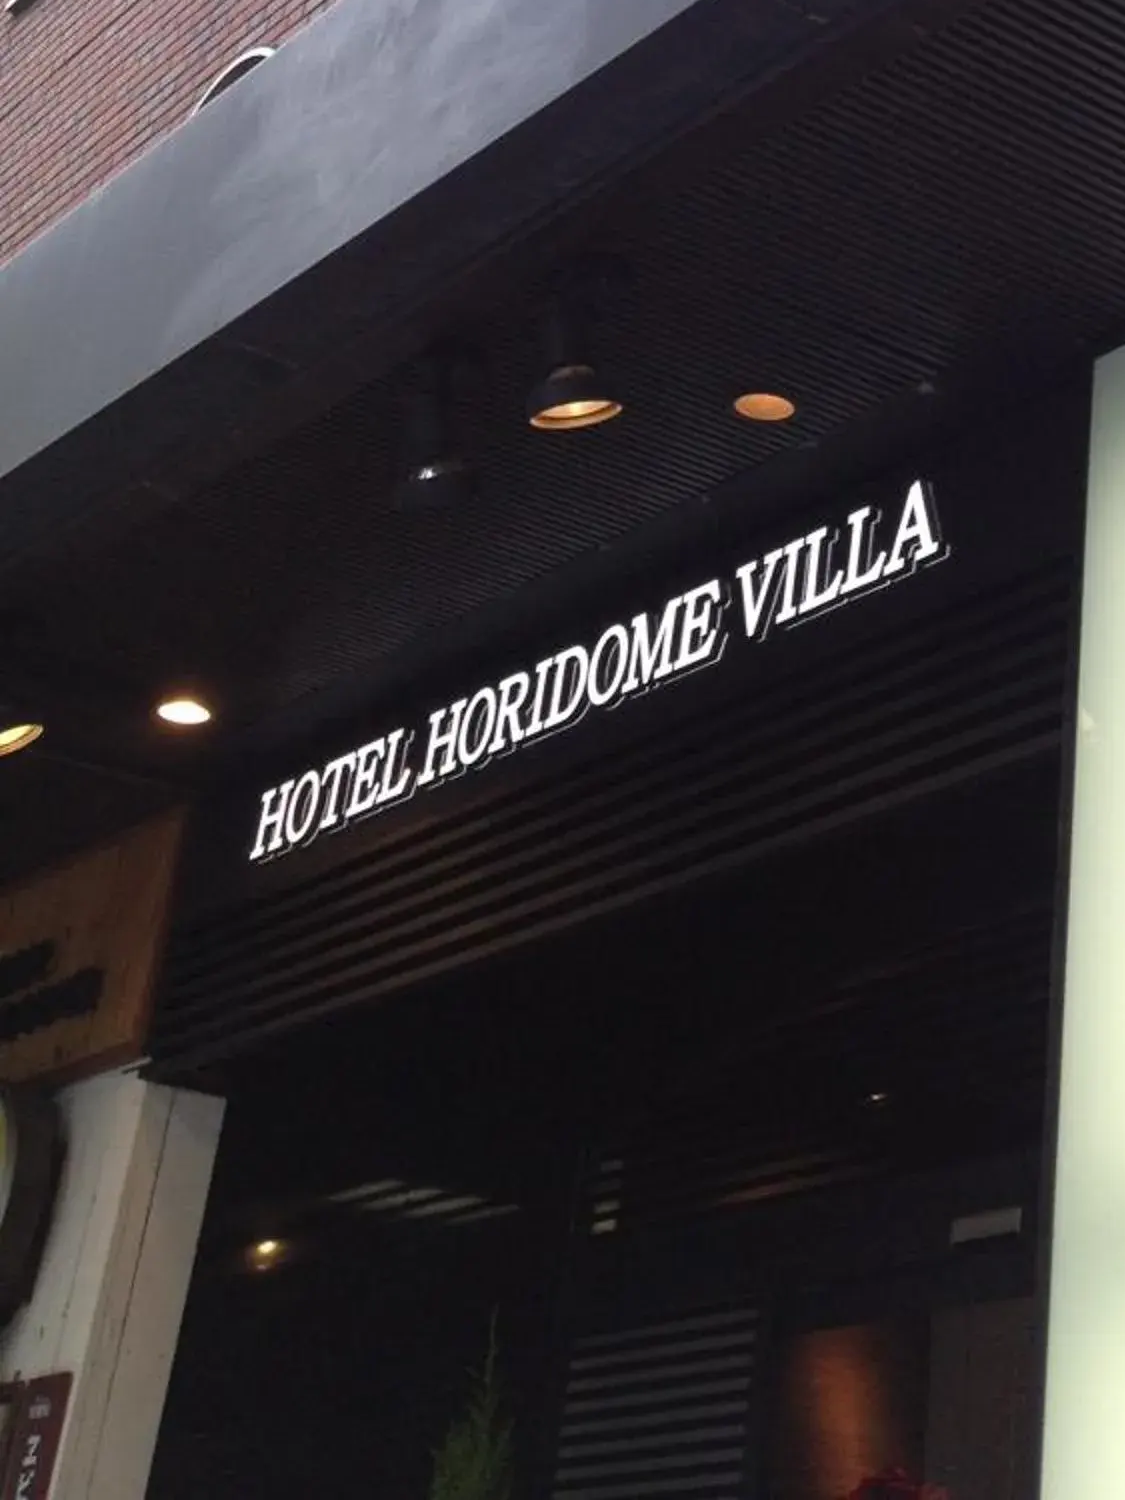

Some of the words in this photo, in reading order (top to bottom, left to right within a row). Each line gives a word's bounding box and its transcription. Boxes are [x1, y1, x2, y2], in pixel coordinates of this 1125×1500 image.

[249, 728, 416, 861] HOTEL
[416, 579, 724, 786] HORIDOME
[735, 479, 941, 639] VILLA
